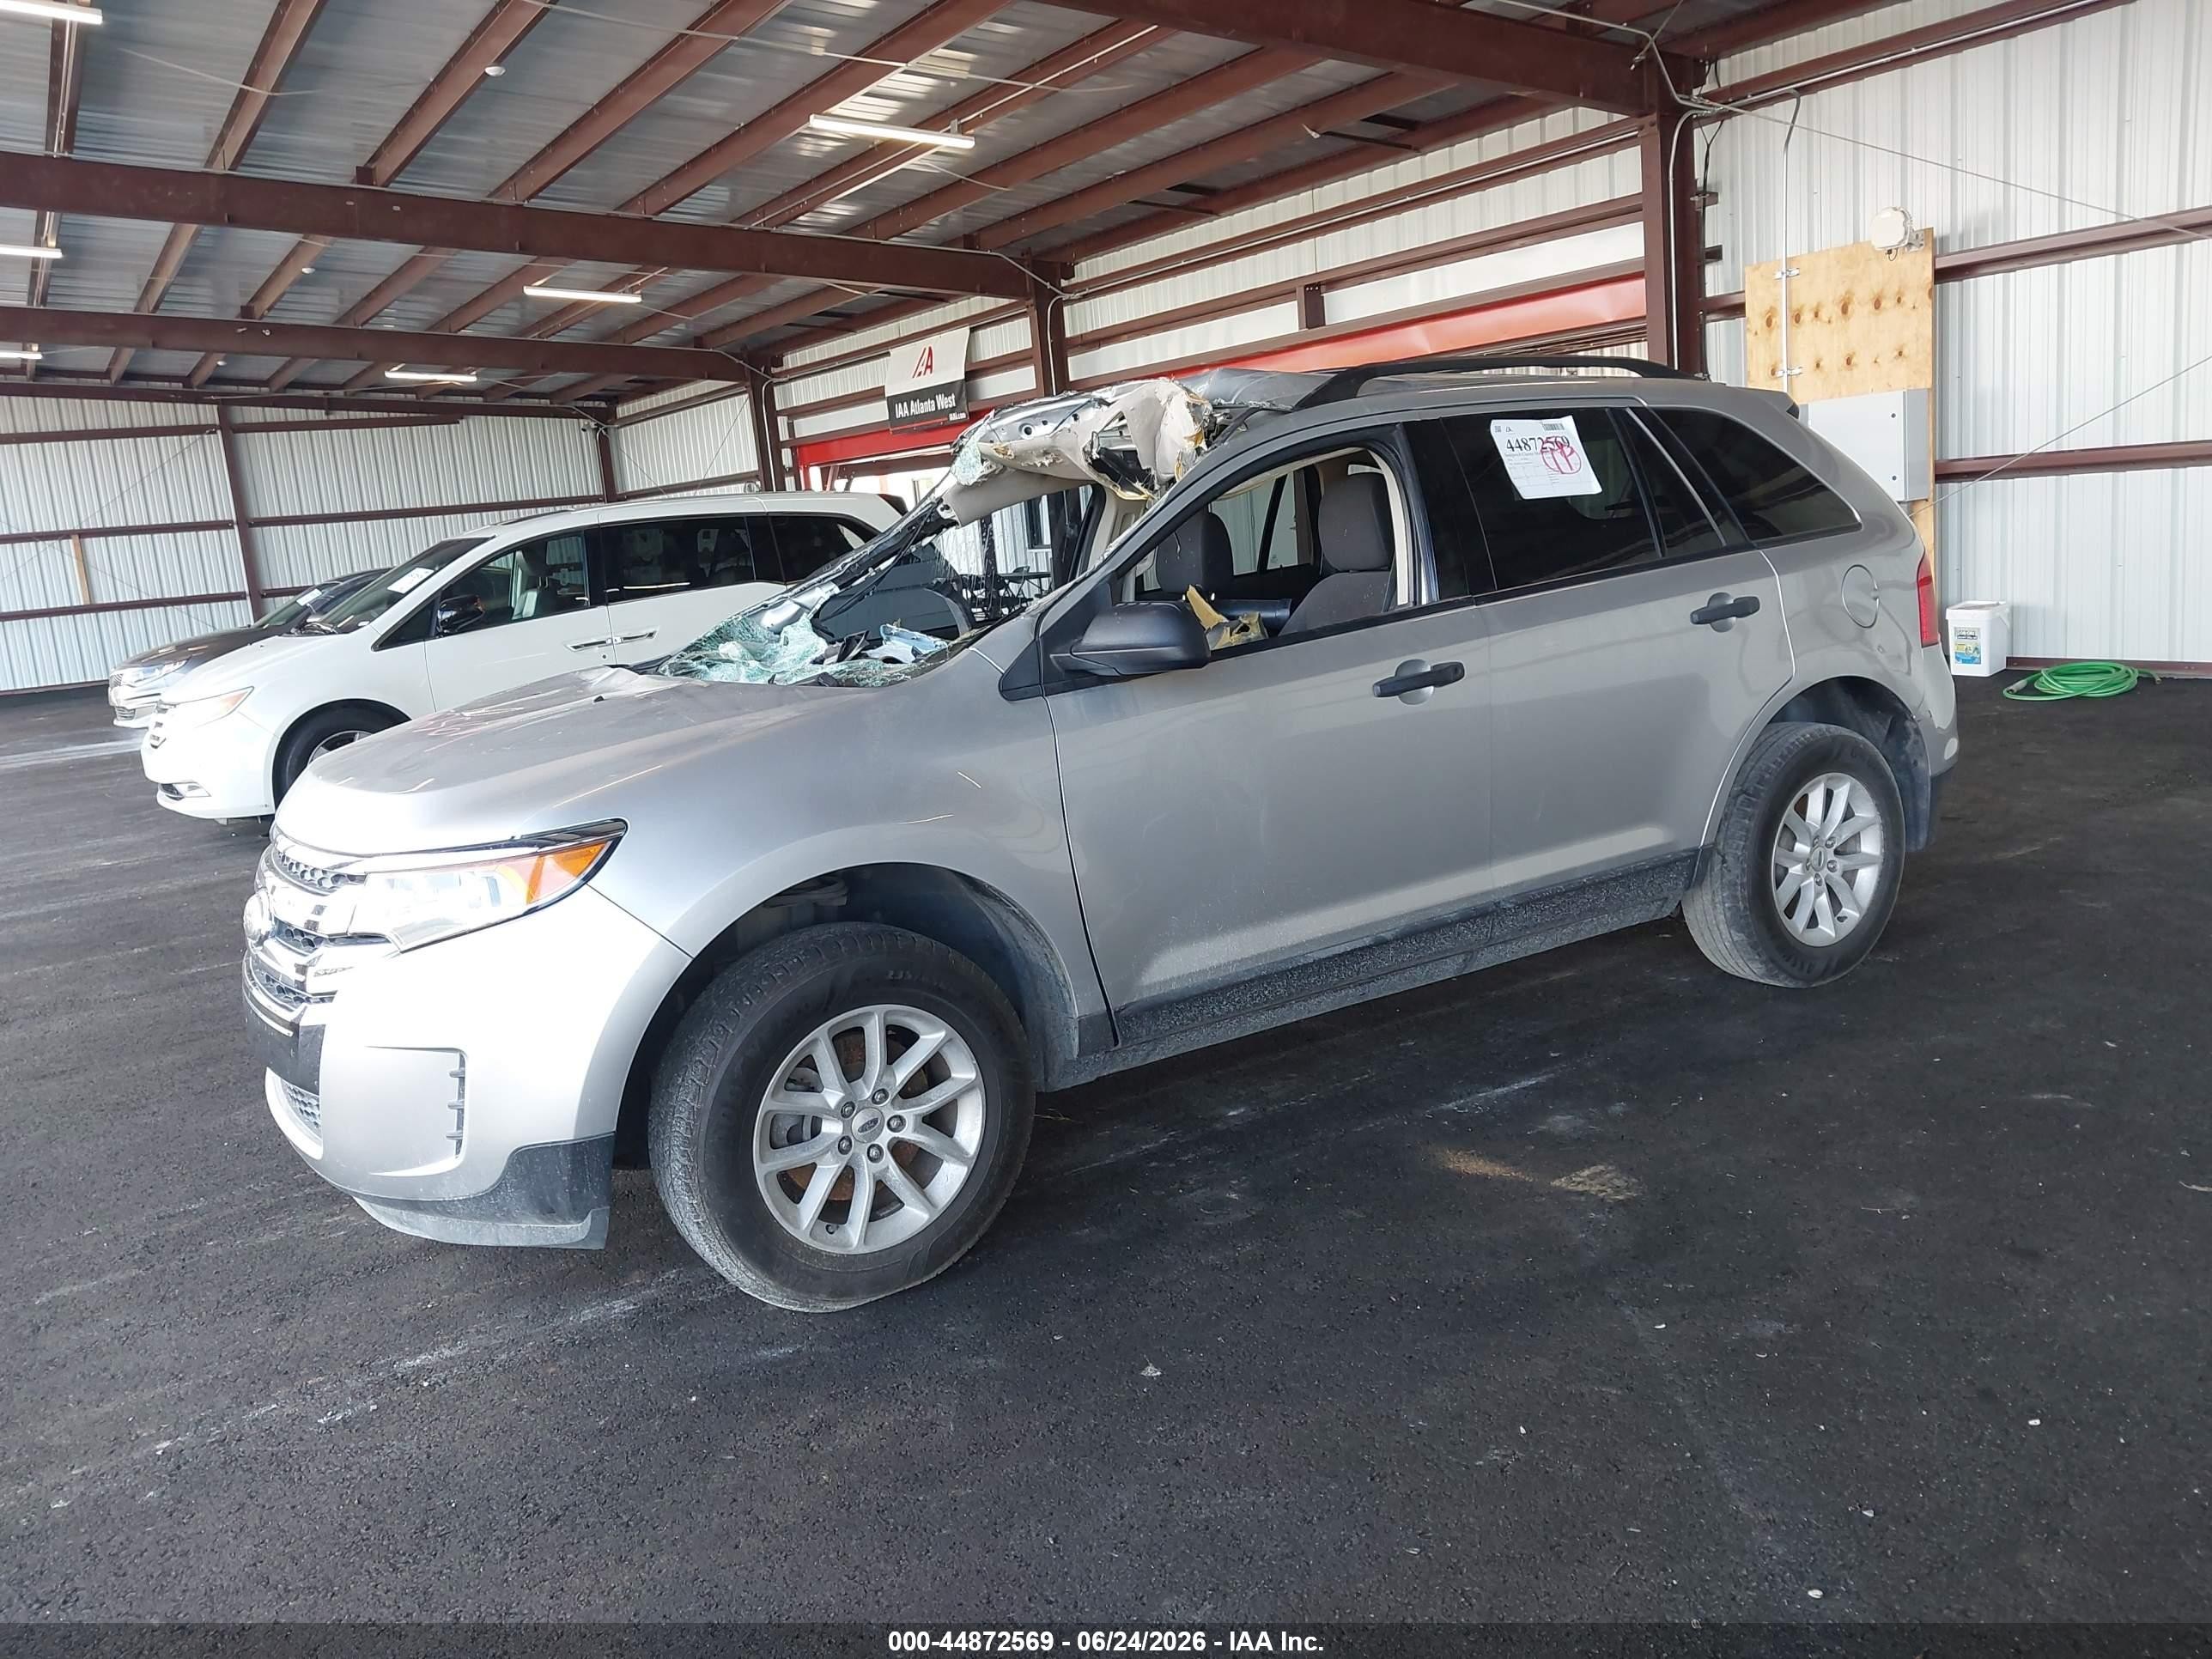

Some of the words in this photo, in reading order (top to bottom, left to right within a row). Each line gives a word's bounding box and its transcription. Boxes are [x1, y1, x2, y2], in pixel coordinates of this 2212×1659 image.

[895, 401, 910, 419] IAA
[910, 398, 936, 416] Atlanta
[935, 392, 956, 410] West
[1506, 435, 1571, 453] 44872569
